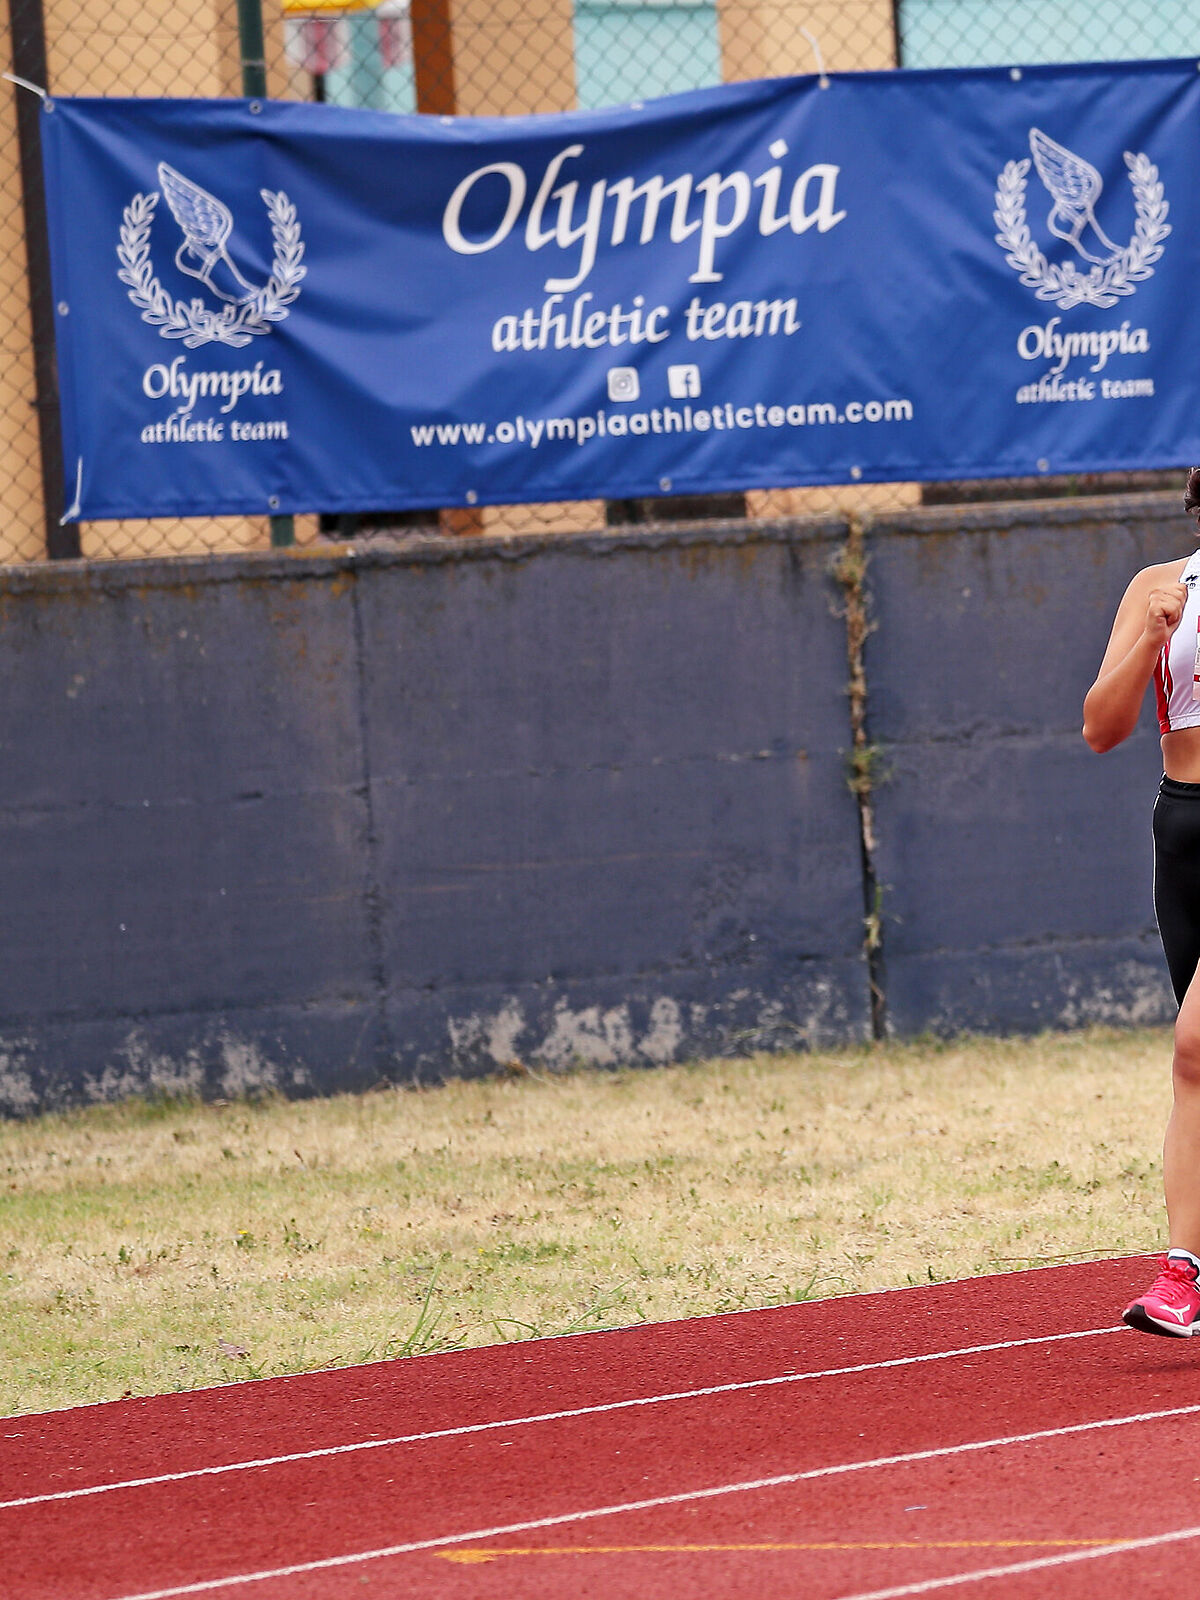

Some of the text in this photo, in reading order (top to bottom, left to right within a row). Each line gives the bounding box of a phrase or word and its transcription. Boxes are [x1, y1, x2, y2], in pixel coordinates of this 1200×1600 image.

[441, 138, 847, 293] Olympia
[490, 292, 801, 352] athletic team
[1016, 316, 1151, 373] Olympia
[141, 355, 284, 414] Olympia
[1015, 372, 1155, 405] athletic team
[140, 413, 289, 444] athletic team
[410, 399, 914, 448] www.olympiaathleticteam.com
